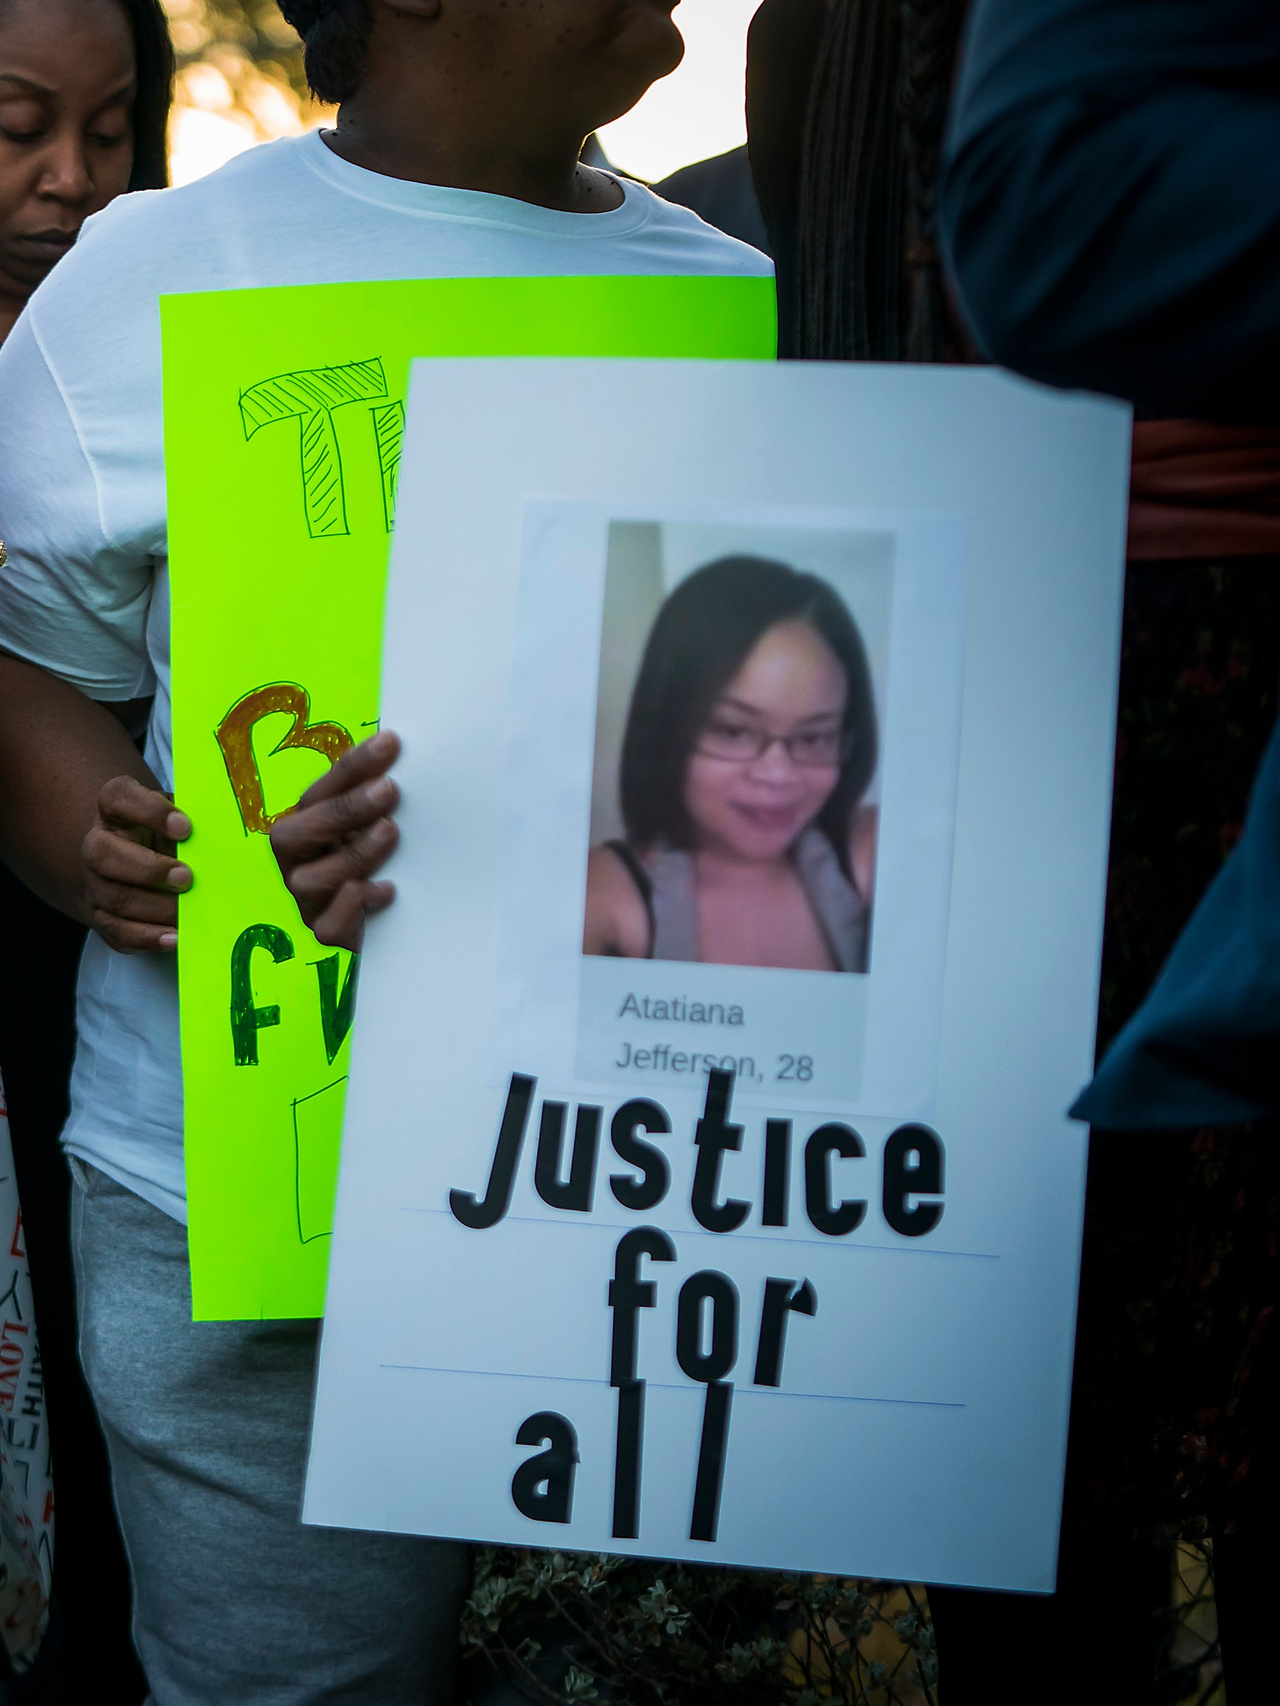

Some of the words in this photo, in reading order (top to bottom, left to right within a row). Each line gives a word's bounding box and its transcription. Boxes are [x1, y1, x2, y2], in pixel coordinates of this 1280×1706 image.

[619, 992, 745, 1027] Atatiana
[776, 1053, 815, 1082] 28
[608, 1224, 818, 1388] for
[511, 1378, 734, 1542] all
